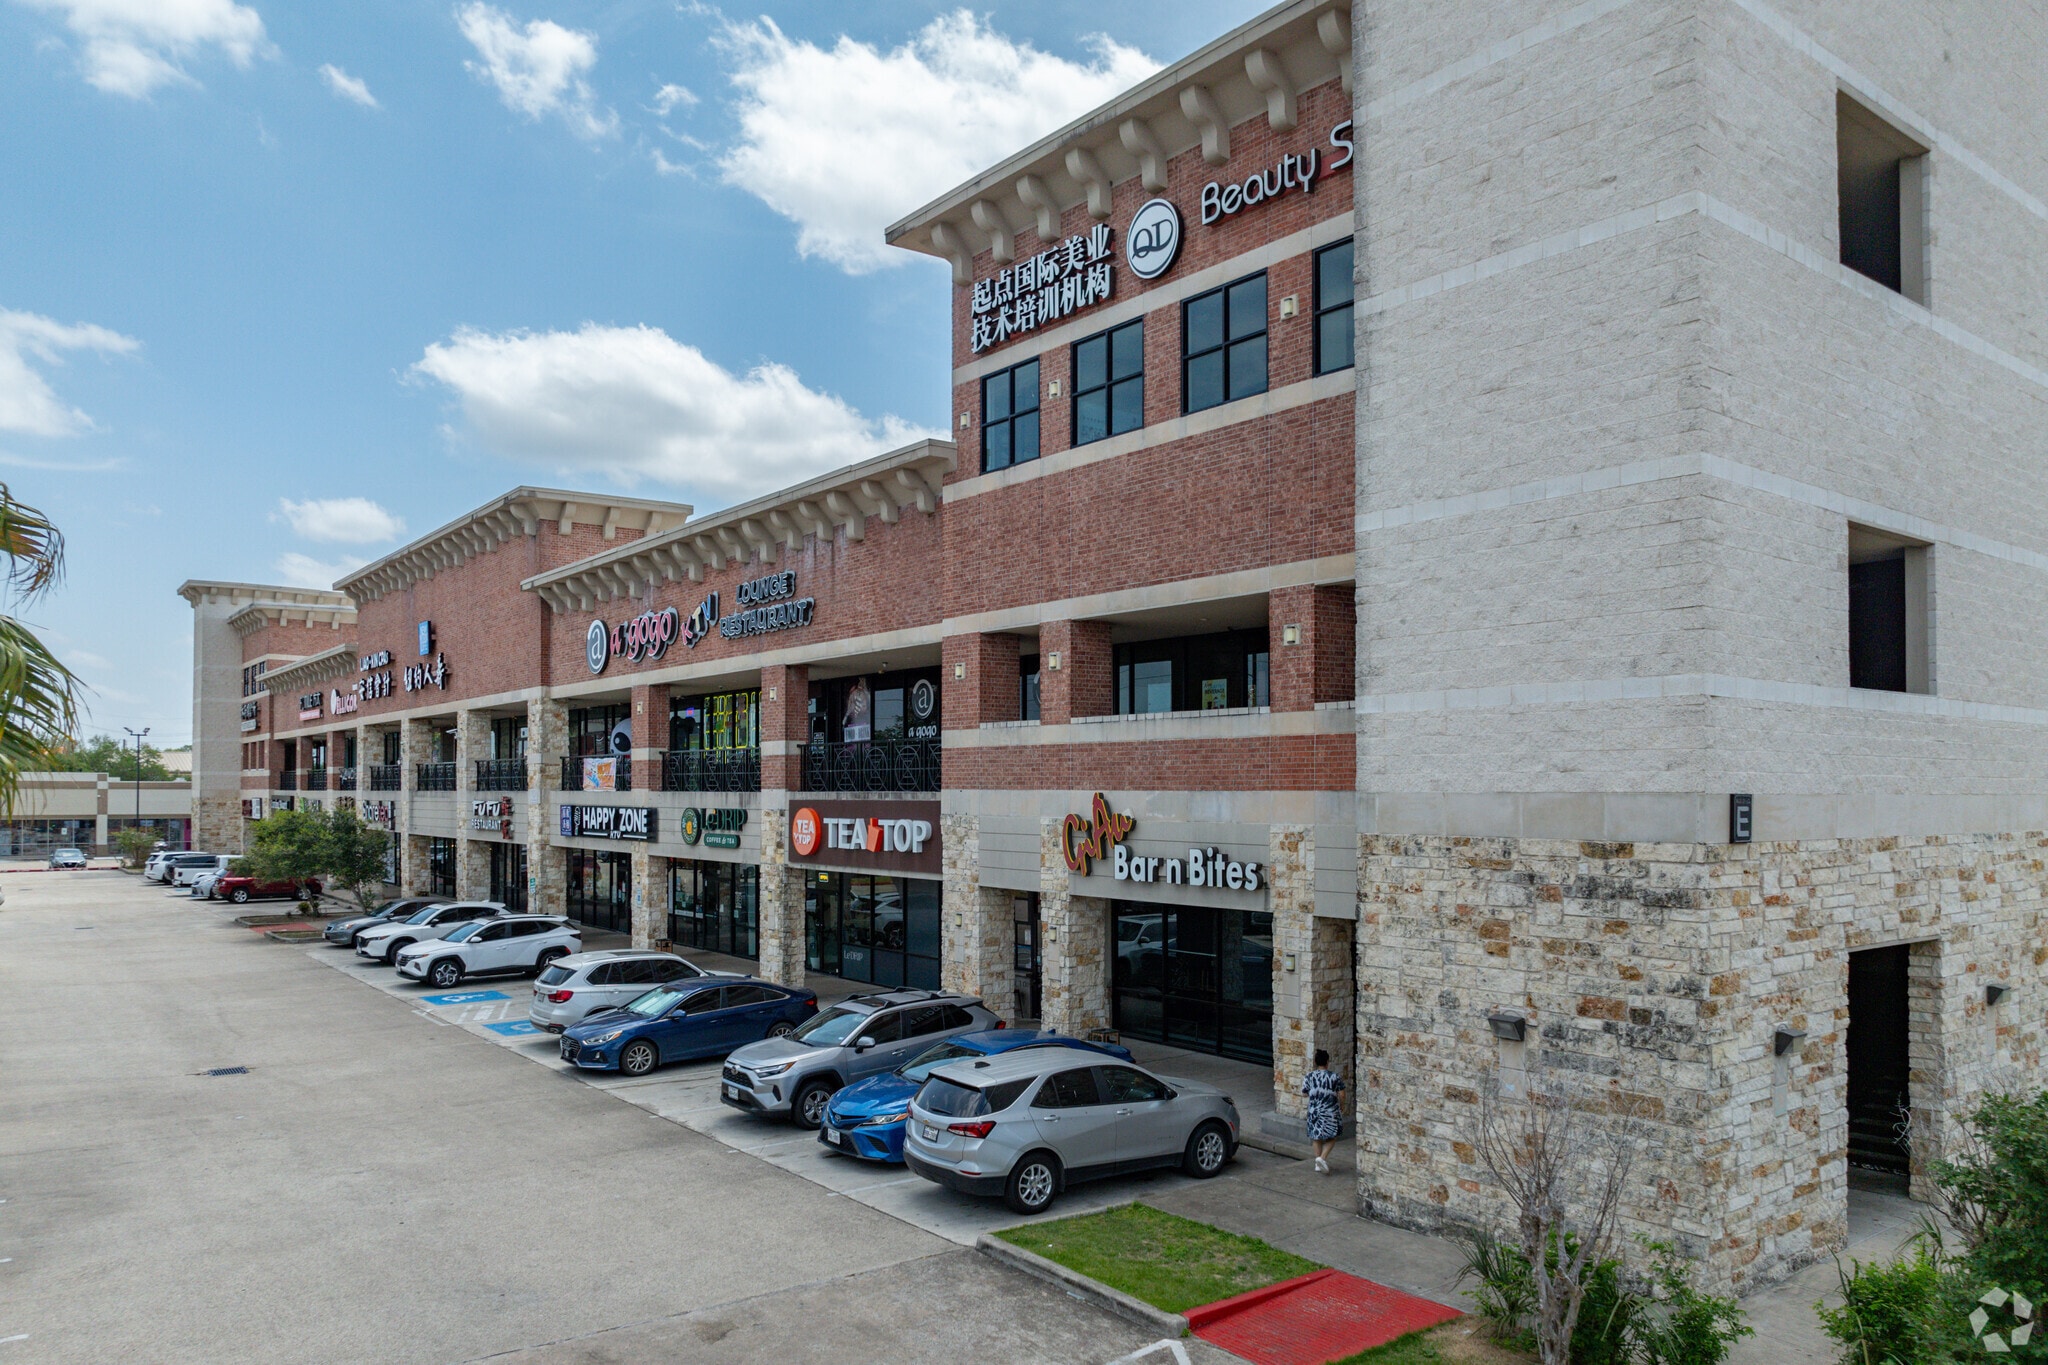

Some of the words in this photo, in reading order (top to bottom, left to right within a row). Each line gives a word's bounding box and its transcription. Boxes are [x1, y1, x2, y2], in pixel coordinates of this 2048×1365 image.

[1201, 148, 1316, 225] Beauty
[971, 223, 1111, 318] 起点国际美业
[971, 263, 1111, 354] 技术培训机构
[736, 571, 791, 605] LOUNGE
[627, 611, 672, 661] gogo
[680, 593, 712, 646] KTV
[720, 598, 809, 638] RESTAURANT
[916, 725, 937, 738] gogo
[472, 800, 501, 817] FUFU
[583, 807, 616, 830] HAPPY
[619, 808, 648, 834] ZONE
[1736, 806, 1750, 837] E
[472, 818, 502, 832] RESTAURANT
[609, 831, 621, 840] KTV
[706, 836, 721, 844] COFFEE
[796, 819, 815, 834] TEA
[798, 834, 811, 845] TOP
[823, 817, 867, 850] TEA
[878, 818, 932, 853] TOP
[1114, 844, 1160, 883] Bar
[1166, 857, 1182, 885] n
[1189, 847, 1259, 892] Bites
